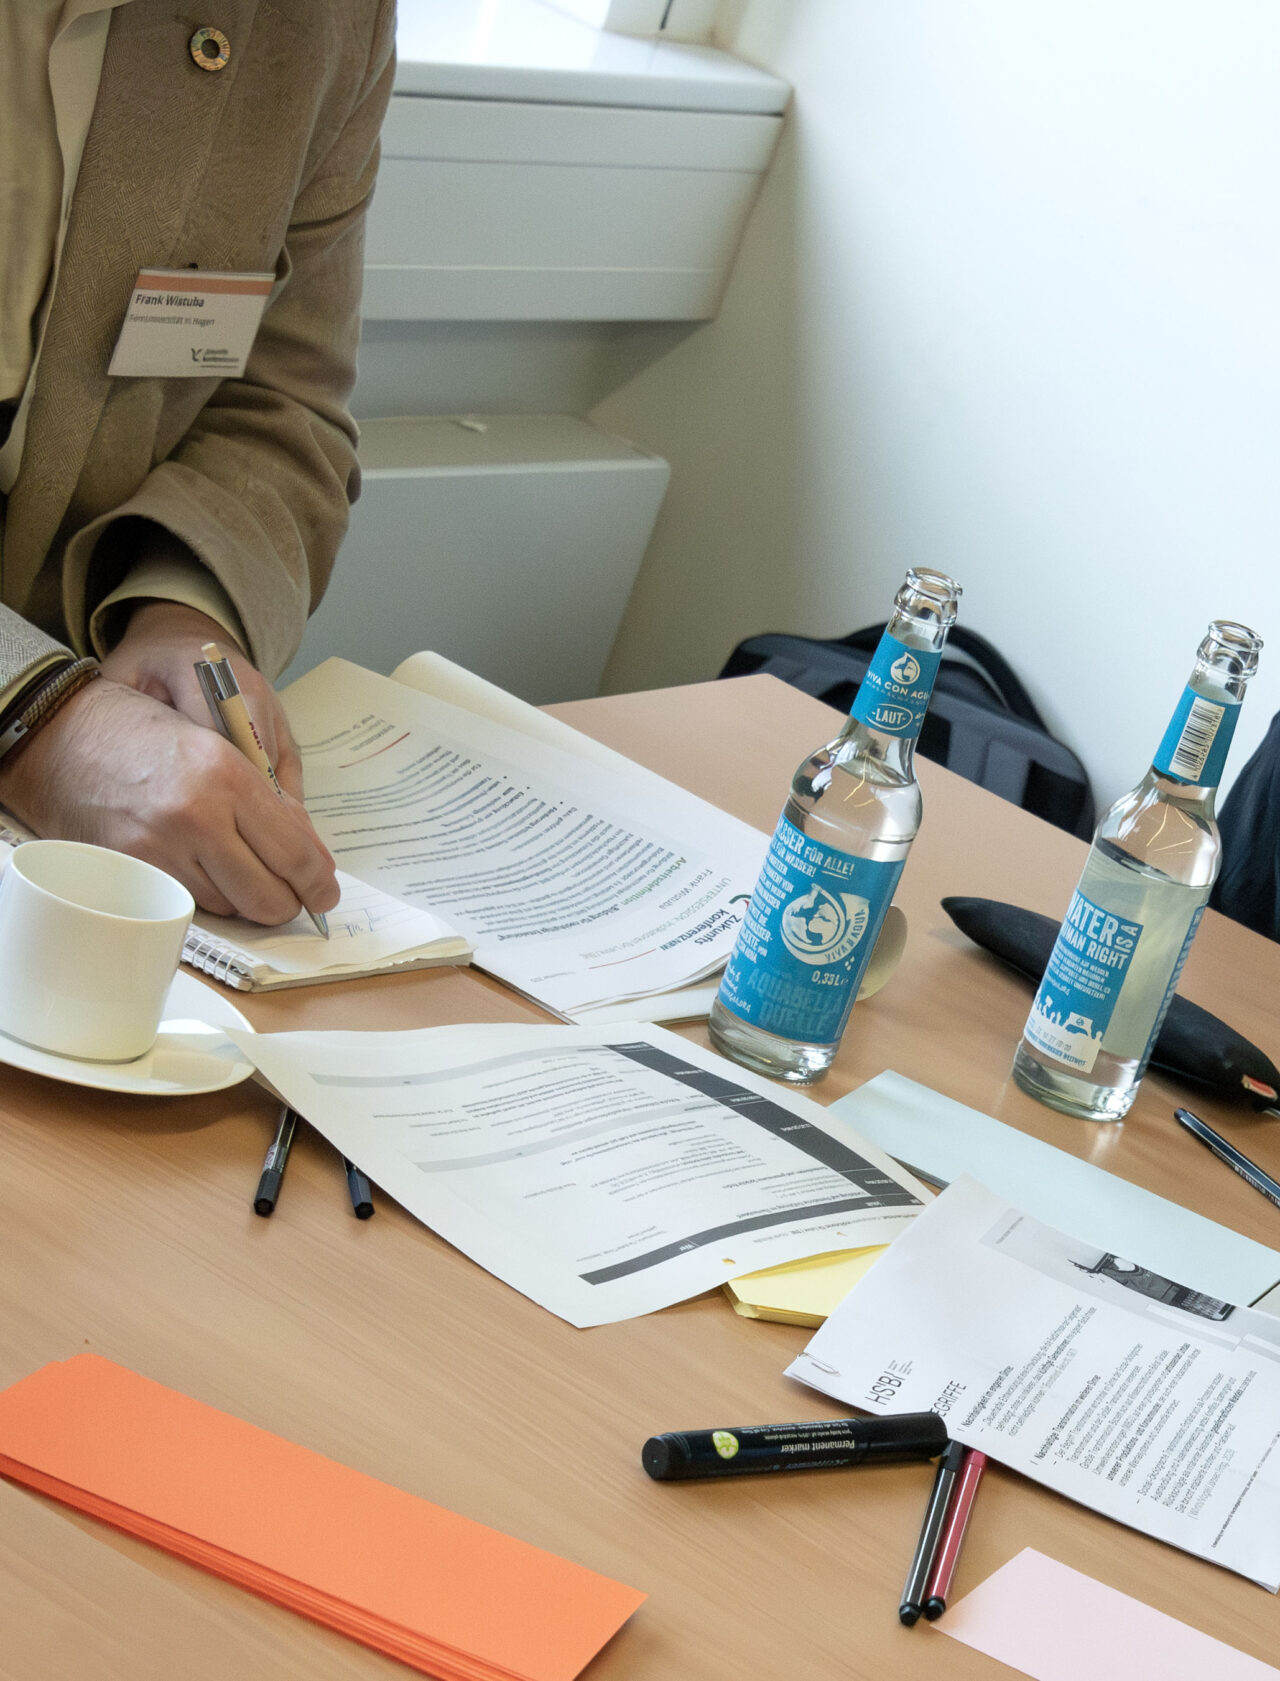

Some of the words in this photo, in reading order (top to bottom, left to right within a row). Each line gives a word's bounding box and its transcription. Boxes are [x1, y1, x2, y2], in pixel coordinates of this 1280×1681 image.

[136, 294, 163, 306] Frank
[165, 294, 205, 308] Wistuba
[884, 682, 909, 697] CON
[804, 845, 822, 865] FÜR
[823, 856, 855, 876] ALLE!
[678, 908, 730, 943] konferenz
[694, 914, 742, 945] Zukunfts
[1114, 937, 1134, 954] IS
[1086, 944, 1129, 971] RIGHT
[934, 1379, 968, 1418] EGRIFFE
[780, 1441, 812, 1453] marker
[811, 1438, 856, 1451] Permanent
